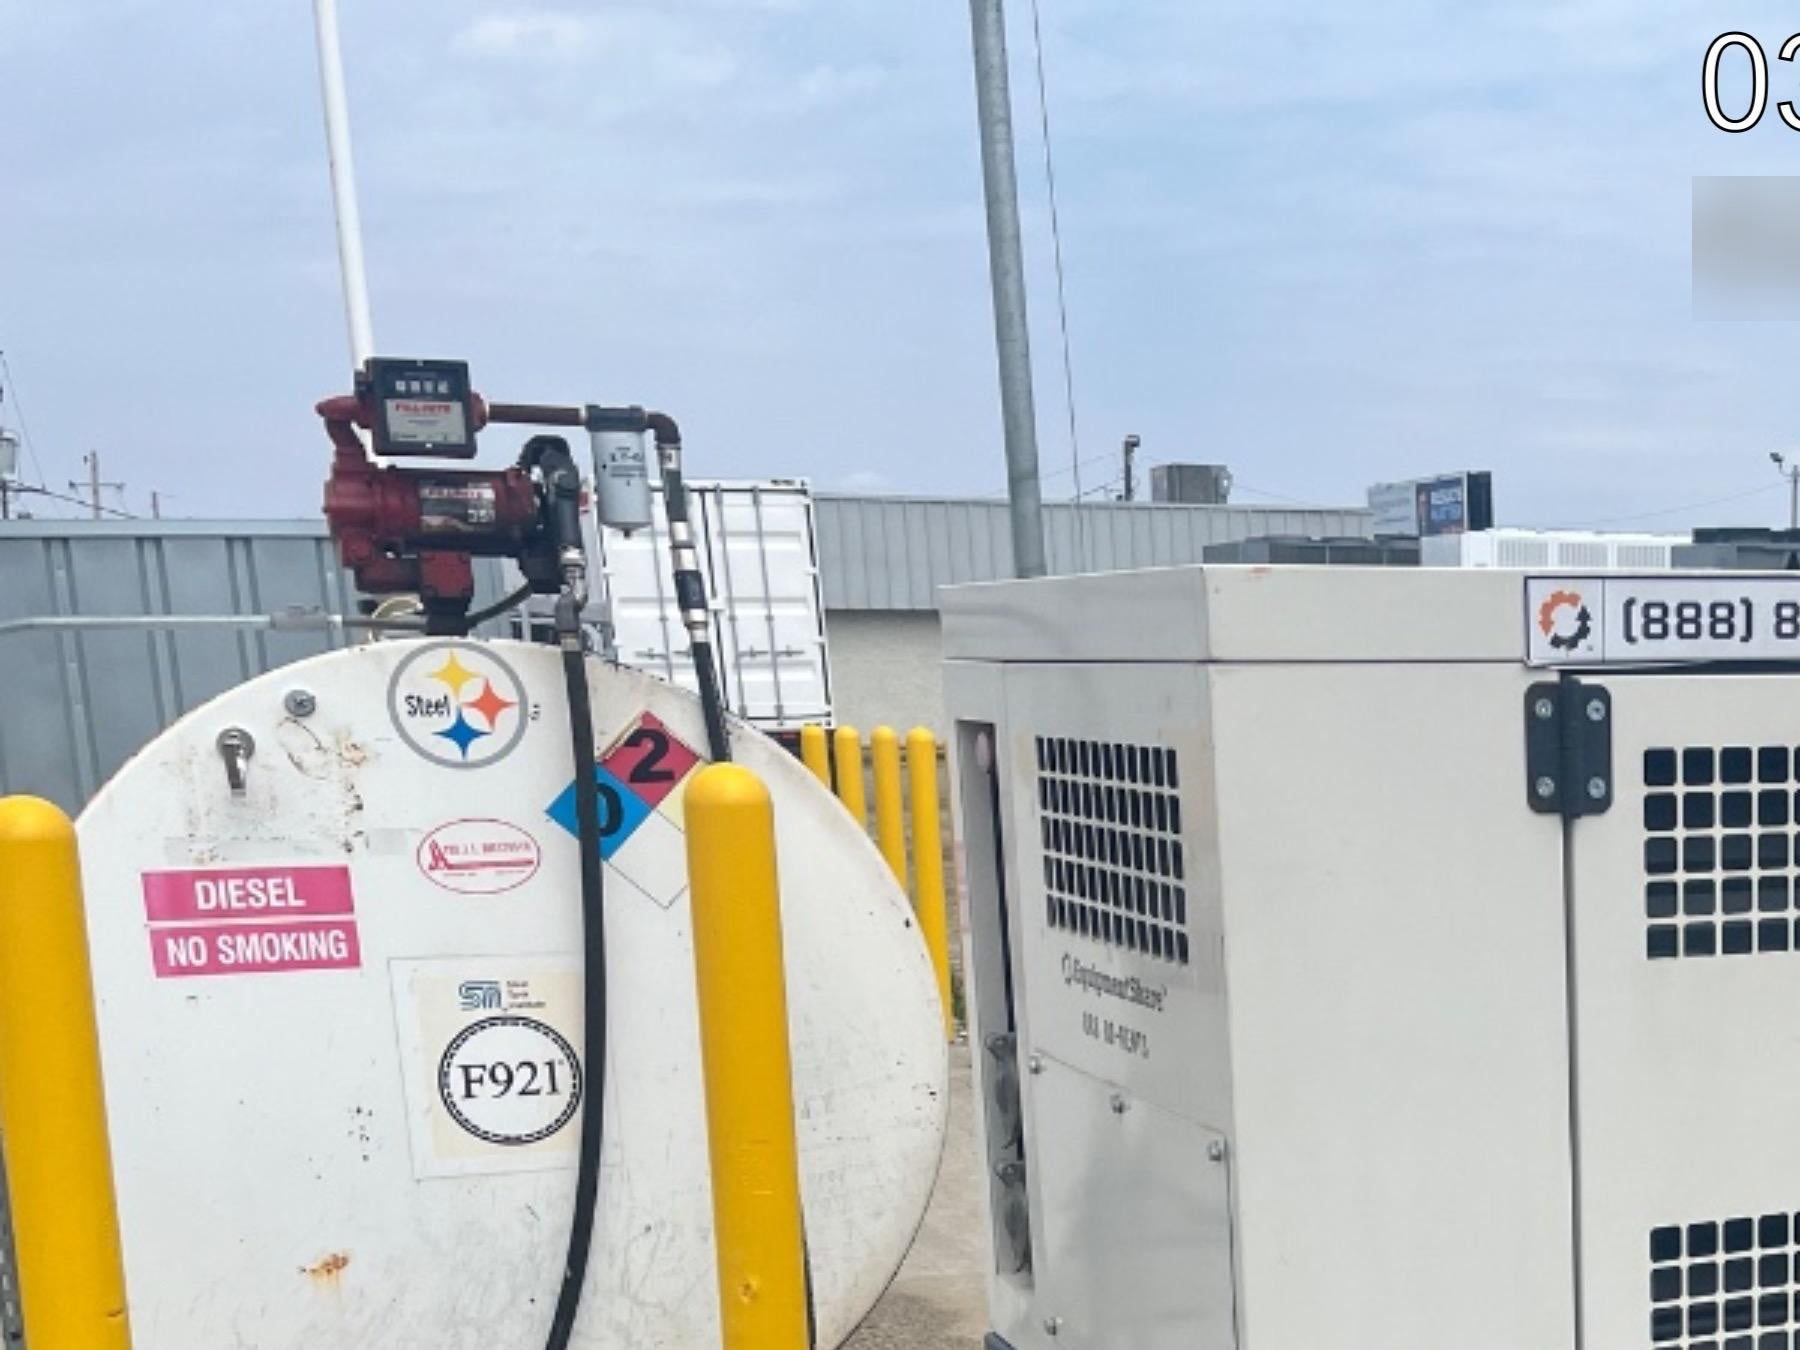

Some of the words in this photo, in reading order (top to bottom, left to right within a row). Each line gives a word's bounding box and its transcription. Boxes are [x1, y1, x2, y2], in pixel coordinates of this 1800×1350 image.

[1622, 596, 1754, 644] (888)
[405, 694, 450, 718] Steel
[623, 728, 676, 784] 2
[195, 876, 306, 910] DIESEL
[166, 936, 208, 967] NO
[217, 929, 348, 965] SMOKING
[457, 1059, 562, 1099] F921
